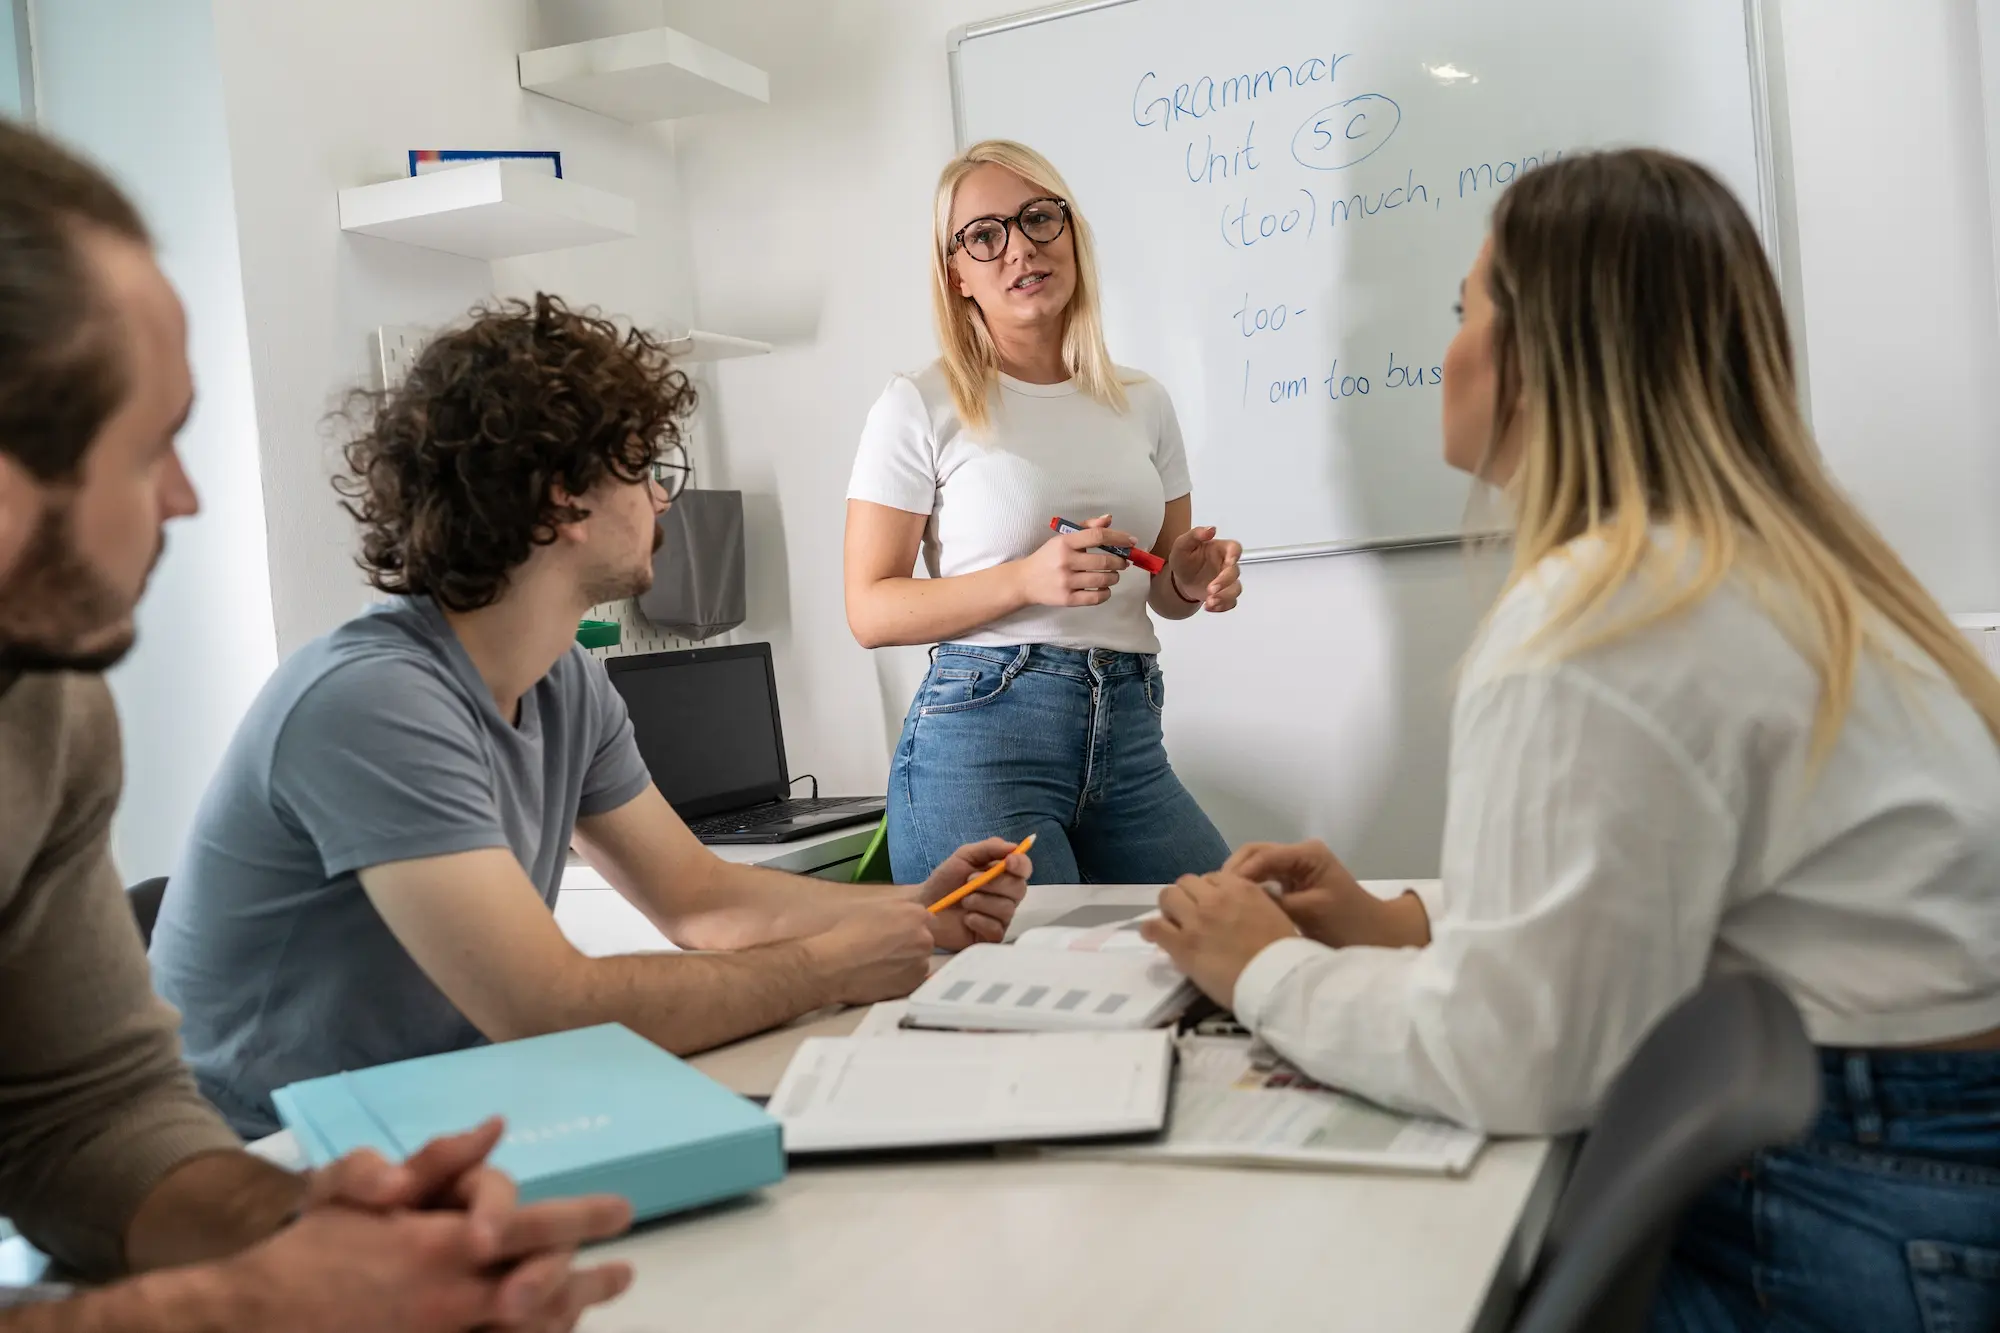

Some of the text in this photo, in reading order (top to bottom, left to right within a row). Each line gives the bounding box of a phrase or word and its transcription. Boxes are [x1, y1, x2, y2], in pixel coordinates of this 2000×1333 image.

[1186, 120, 1260, 183] Unit
[1220, 187, 1317, 249] (too)
[1331, 167, 1441, 227] much,
[1233, 291, 1308, 338] too-
[1269, 376, 1308, 403] am
[1323, 358, 1371, 401] too
[1385, 352, 1443, 388] bus
